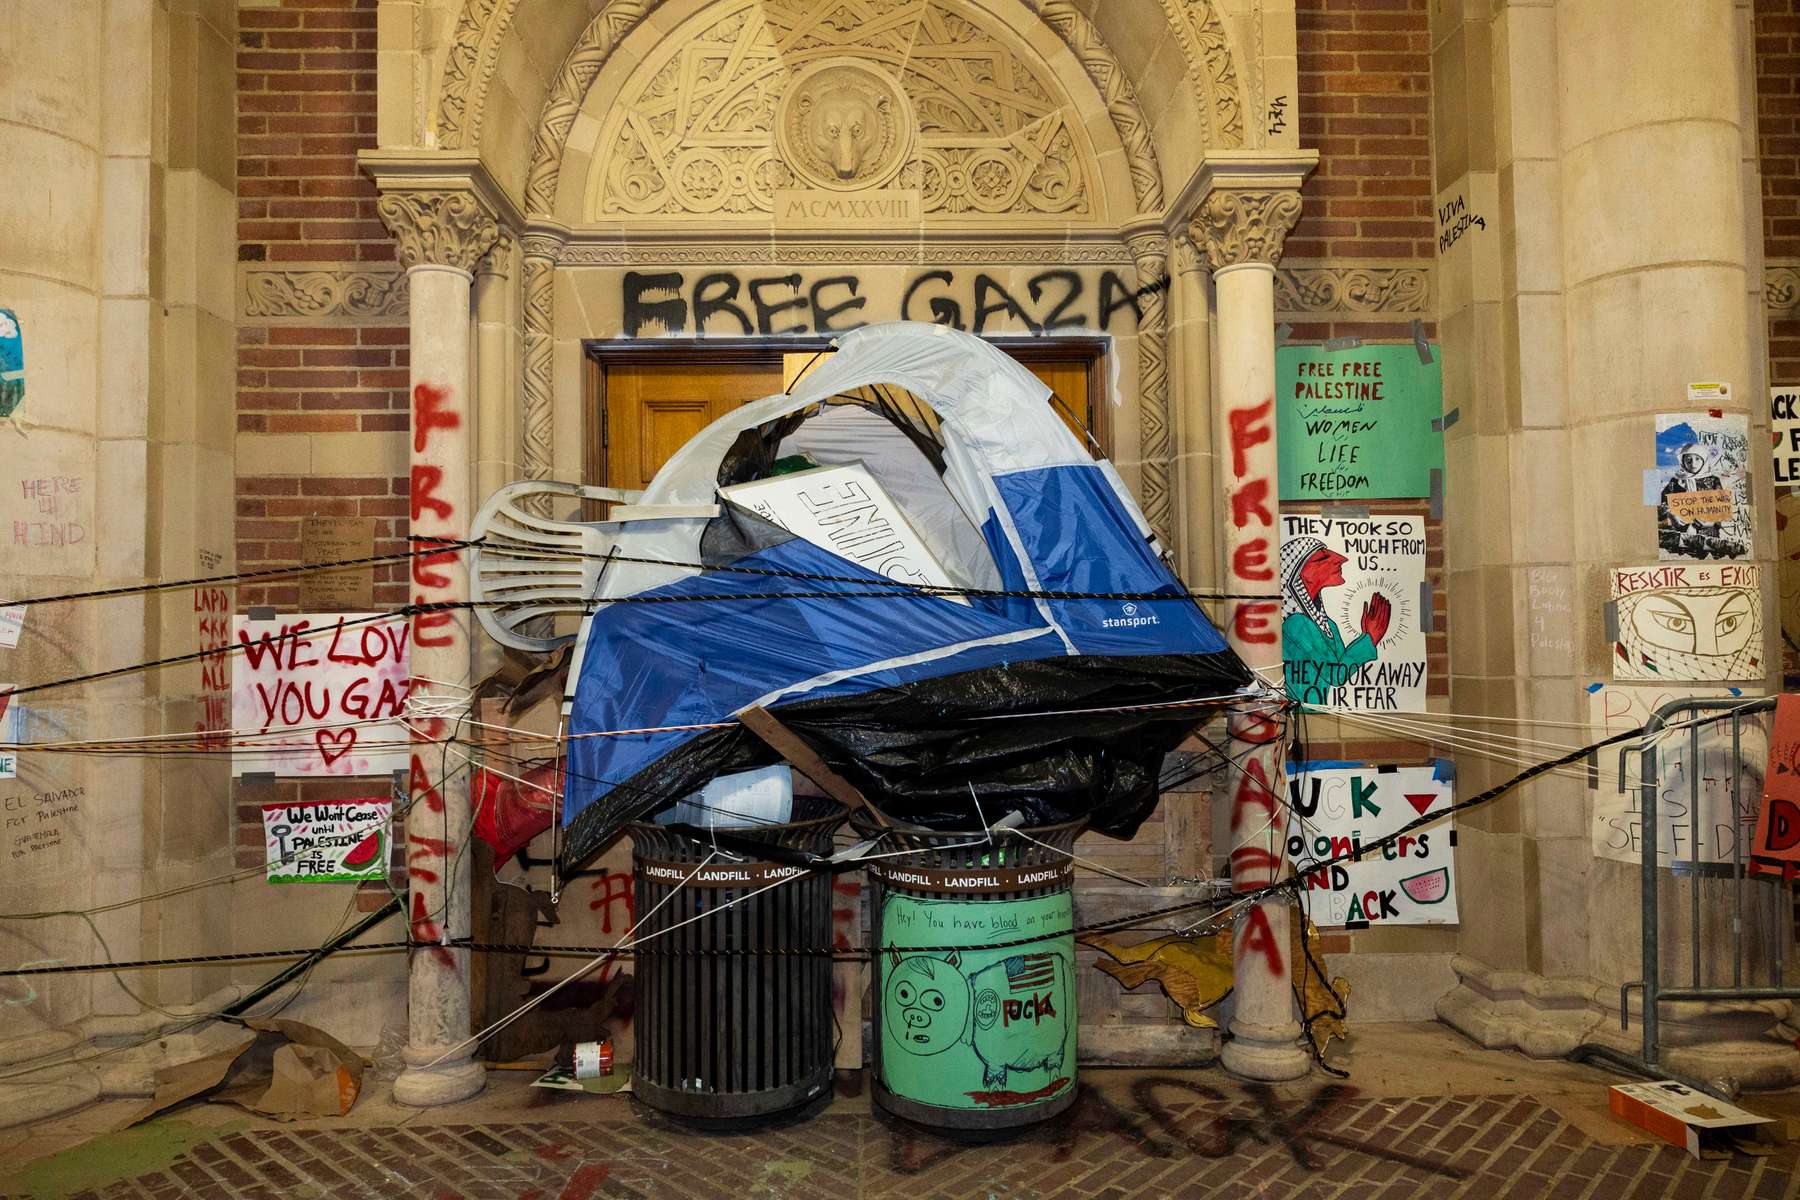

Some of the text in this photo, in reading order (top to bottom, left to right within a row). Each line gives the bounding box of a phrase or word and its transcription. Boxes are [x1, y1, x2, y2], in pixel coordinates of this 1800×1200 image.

[785, 200, 909, 218] MCMXXVIII
[1438, 194, 1465, 227] VIVA
[622, 270, 867, 341] FREE
[1298, 362, 1383, 378] FREE FREE
[1295, 381, 1385, 401] PALESTINE
[1305, 419, 1379, 437] WOMEN
[1318, 441, 1361, 464] LIFE
[1300, 472, 1370, 492] FREEDOM
[1672, 496, 1698, 508] STOP
[1702, 496, 1714, 505] THE
[1680, 507, 1695, 517] ON
[409, 380, 462, 647] FREE
[1227, 397, 1278, 646] FREE
[1284, 517, 1413, 538] THEY TOOK SO
[1345, 538, 1425, 556] MUCH FROM
[1358, 557, 1397, 571] US...
[1617, 567, 1690, 594] RESISTIR
[1700, 572, 1710, 581] ES
[194, 588, 229, 612] LAPD
[200, 618, 229, 642] KKK
[1102, 615, 1160, 628] stansport
[239, 616, 411, 671] WE LOV
[1283, 660, 1425, 688] THEY TOOK AWAY
[256, 678, 331, 735] YOU
[1303, 686, 1398, 709] OUR FEAR
[1289, 775, 1382, 821] UCK
[286, 806, 312, 824] We
[346, 805, 379, 822] Cease
[311, 823, 335, 835] until
[291, 832, 364, 850] PALESTINE
[310, 850, 323, 860] IS
[296, 859, 336, 874] FREE
[645, 865, 686, 880] LANDFILL
[697, 871, 751, 881] LANDFILL
[888, 870, 932, 886] LANDFILL
[944, 876, 1000, 887] LANDFILL
[1018, 870, 1058, 884] LANDFILL
[1329, 889, 1400, 924] BACK
[923, 910, 945, 929] You
[953, 915, 985, 929] have
[991, 914, 1018, 929] blood
